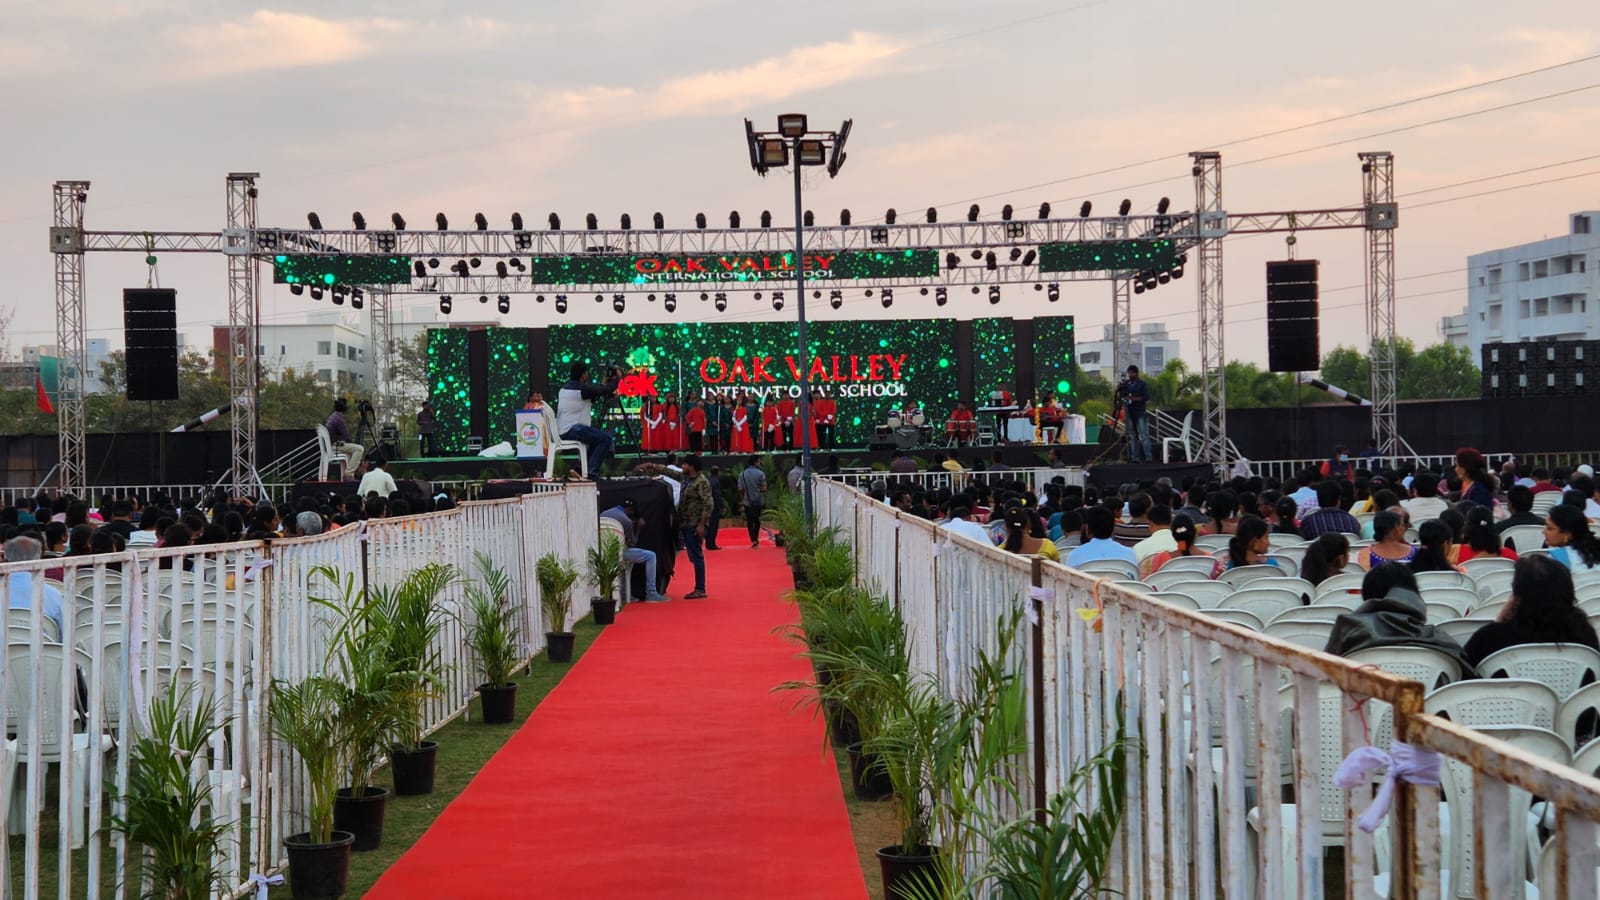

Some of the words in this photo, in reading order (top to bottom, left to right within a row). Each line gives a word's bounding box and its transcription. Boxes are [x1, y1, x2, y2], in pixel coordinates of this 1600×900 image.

[635, 258, 707, 273] OAK
[719, 255, 835, 272] VALLEY
[636, 270, 765, 281] INTERNATIONAL
[699, 355, 776, 384] OAK
[840, 383, 908, 398] SCHOOL
